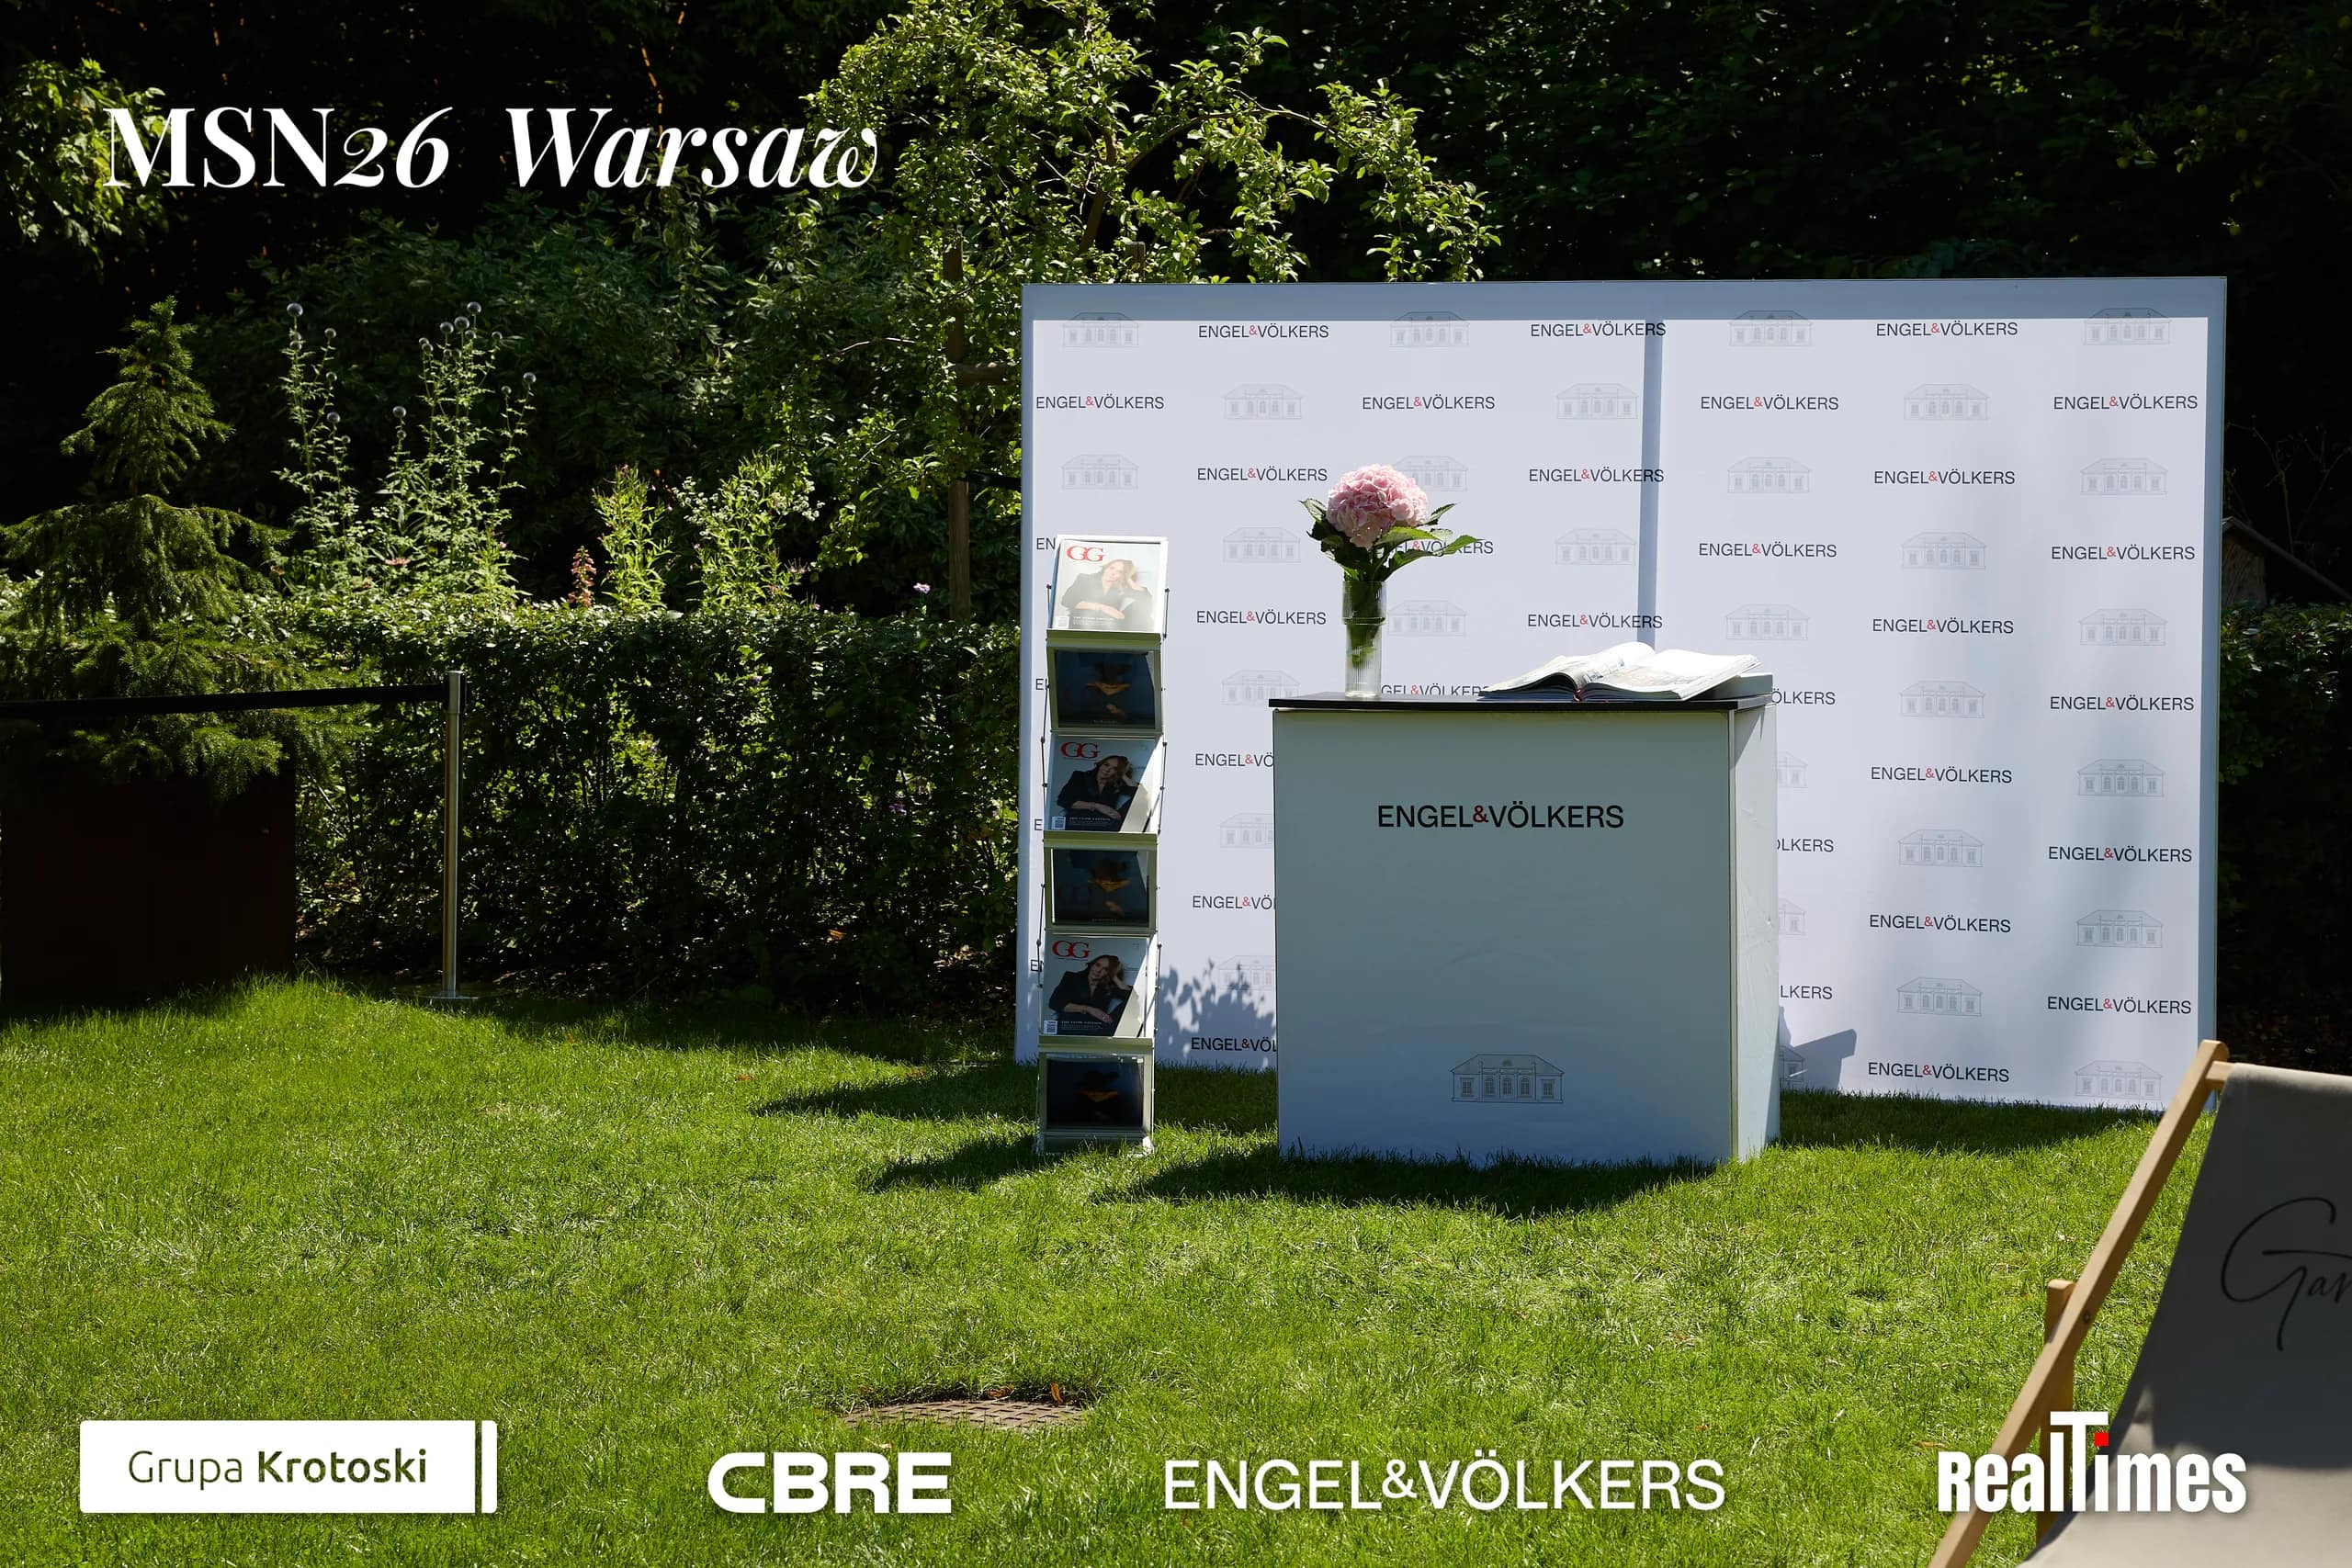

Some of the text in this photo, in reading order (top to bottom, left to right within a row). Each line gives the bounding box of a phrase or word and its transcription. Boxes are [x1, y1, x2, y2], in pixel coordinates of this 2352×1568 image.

[1197, 322, 1329, 339] ENGEL&VÖLKERS
[1530, 320, 1667, 339] ENGEL&VÖLKERS
[1875, 320, 2018, 338] ENGEL&VÖLKERS
[1035, 393, 1165, 411] ENGEL&VÖLKERS
[1362, 393, 1496, 411] ENGEL&VÖLKERS
[1700, 393, 1839, 412] ENGEL&VÖLKERS
[2052, 393, 2199, 412] ENGEL&VÖLKERS
[1196, 466, 1328, 483] ENGEL&VÖLKERS
[1528, 466, 1665, 484] ENGEL&VÖLKERS
[1873, 468, 2016, 486] ENGEL&VÖLKERS
[1066, 545, 1105, 562] GG
[1698, 541, 1838, 559] ENGEL&VÖLKERS
[2051, 544, 2196, 561] ENGEL&VÖLKERS
[1196, 608, 1327, 626] ENGEL&VÖLKERS
[1527, 612, 1663, 629] ENGEL&VÖLKERS
[1871, 616, 2014, 636] ENGEL&VÖLKERS
[2049, 694, 2195, 712] ENGEL&VÖLKERS
[1060, 740, 1102, 760] GG
[1870, 765, 2013, 784] ENGEL&VÖLKERS
[1377, 800, 1625, 829] ENGEL&VÖLKERS
[2047, 844, 2193, 863] ENGEL&VÖLKERS
[1192, 894, 1276, 911] ENGEL&VÖ
[1869, 913, 2011, 934] ENGEL&VÖLKERS
[1052, 940, 1091, 959] GG
[2046, 995, 2192, 1015] ENGEL&VÖLKERS
[1867, 1060, 2010, 1084] ENGEL&VÖLKERS
